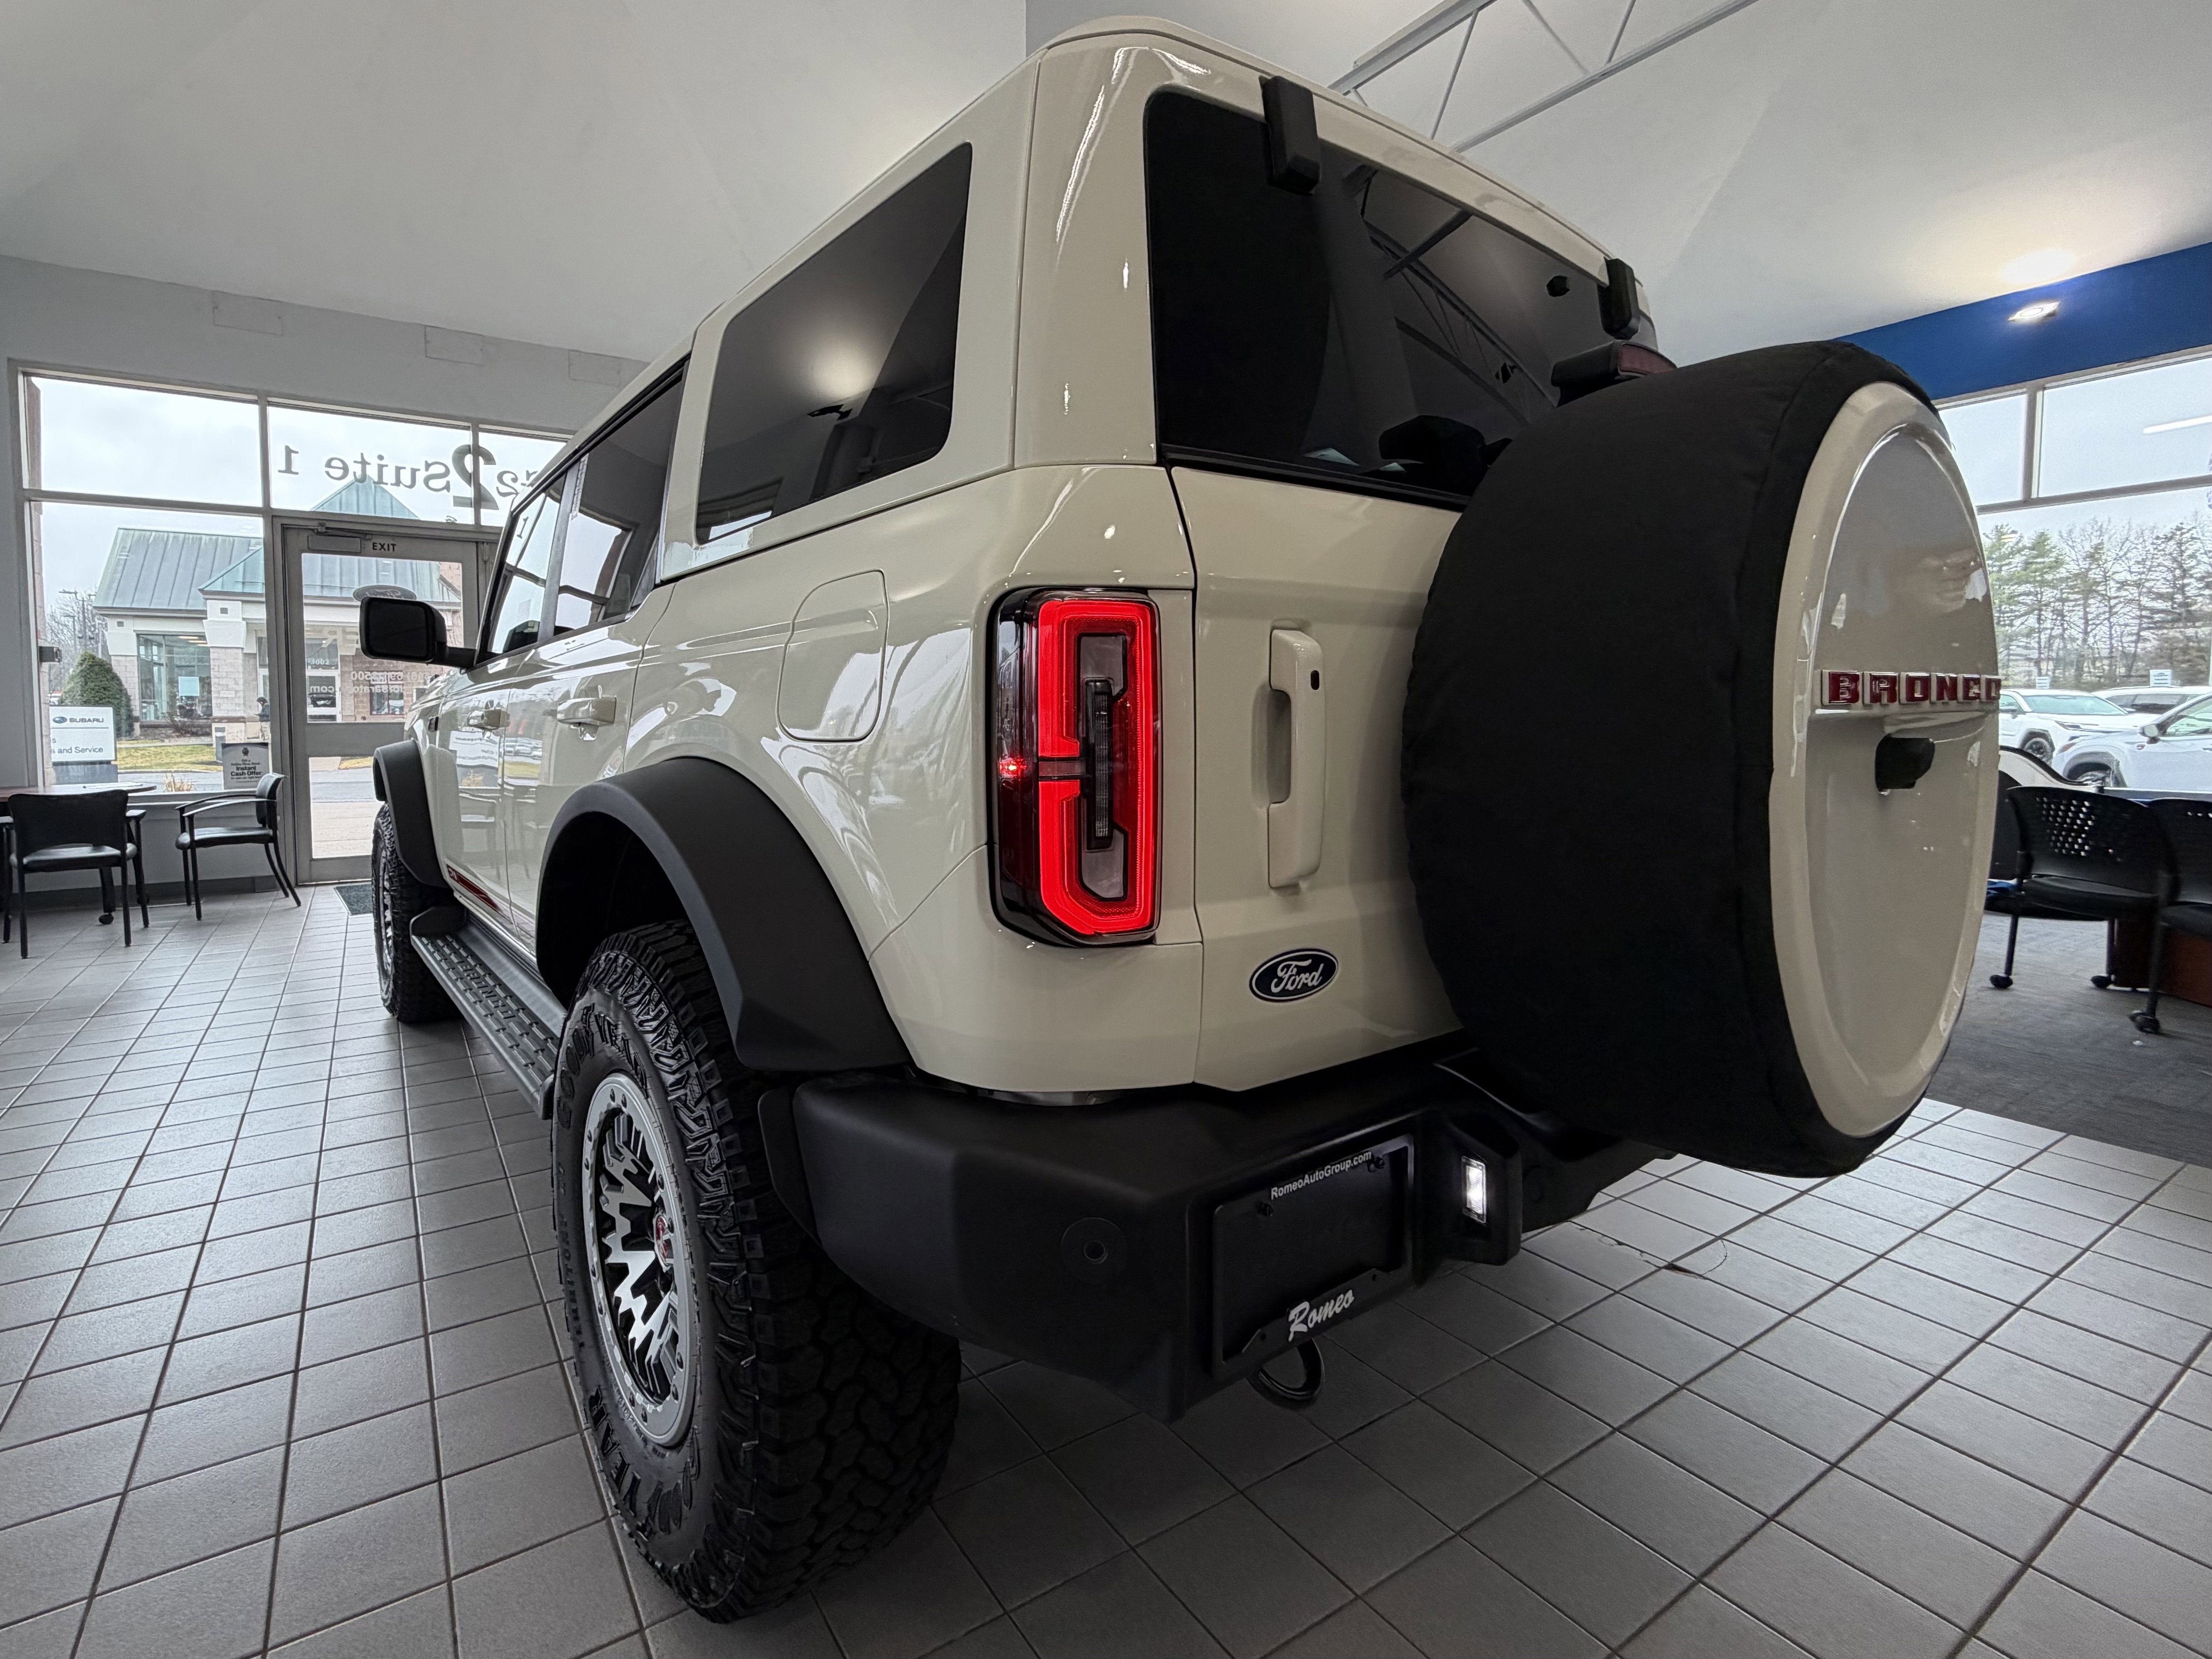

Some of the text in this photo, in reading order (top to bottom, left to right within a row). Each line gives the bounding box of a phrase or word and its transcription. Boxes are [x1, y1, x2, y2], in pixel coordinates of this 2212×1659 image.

[373, 542, 396, 552] EXIT
[1271, 959, 1324, 993] Ford
[1271, 1151, 1372, 1200] RomeoAutoGroup.com
[1288, 1289, 1354, 1342] Romeo
